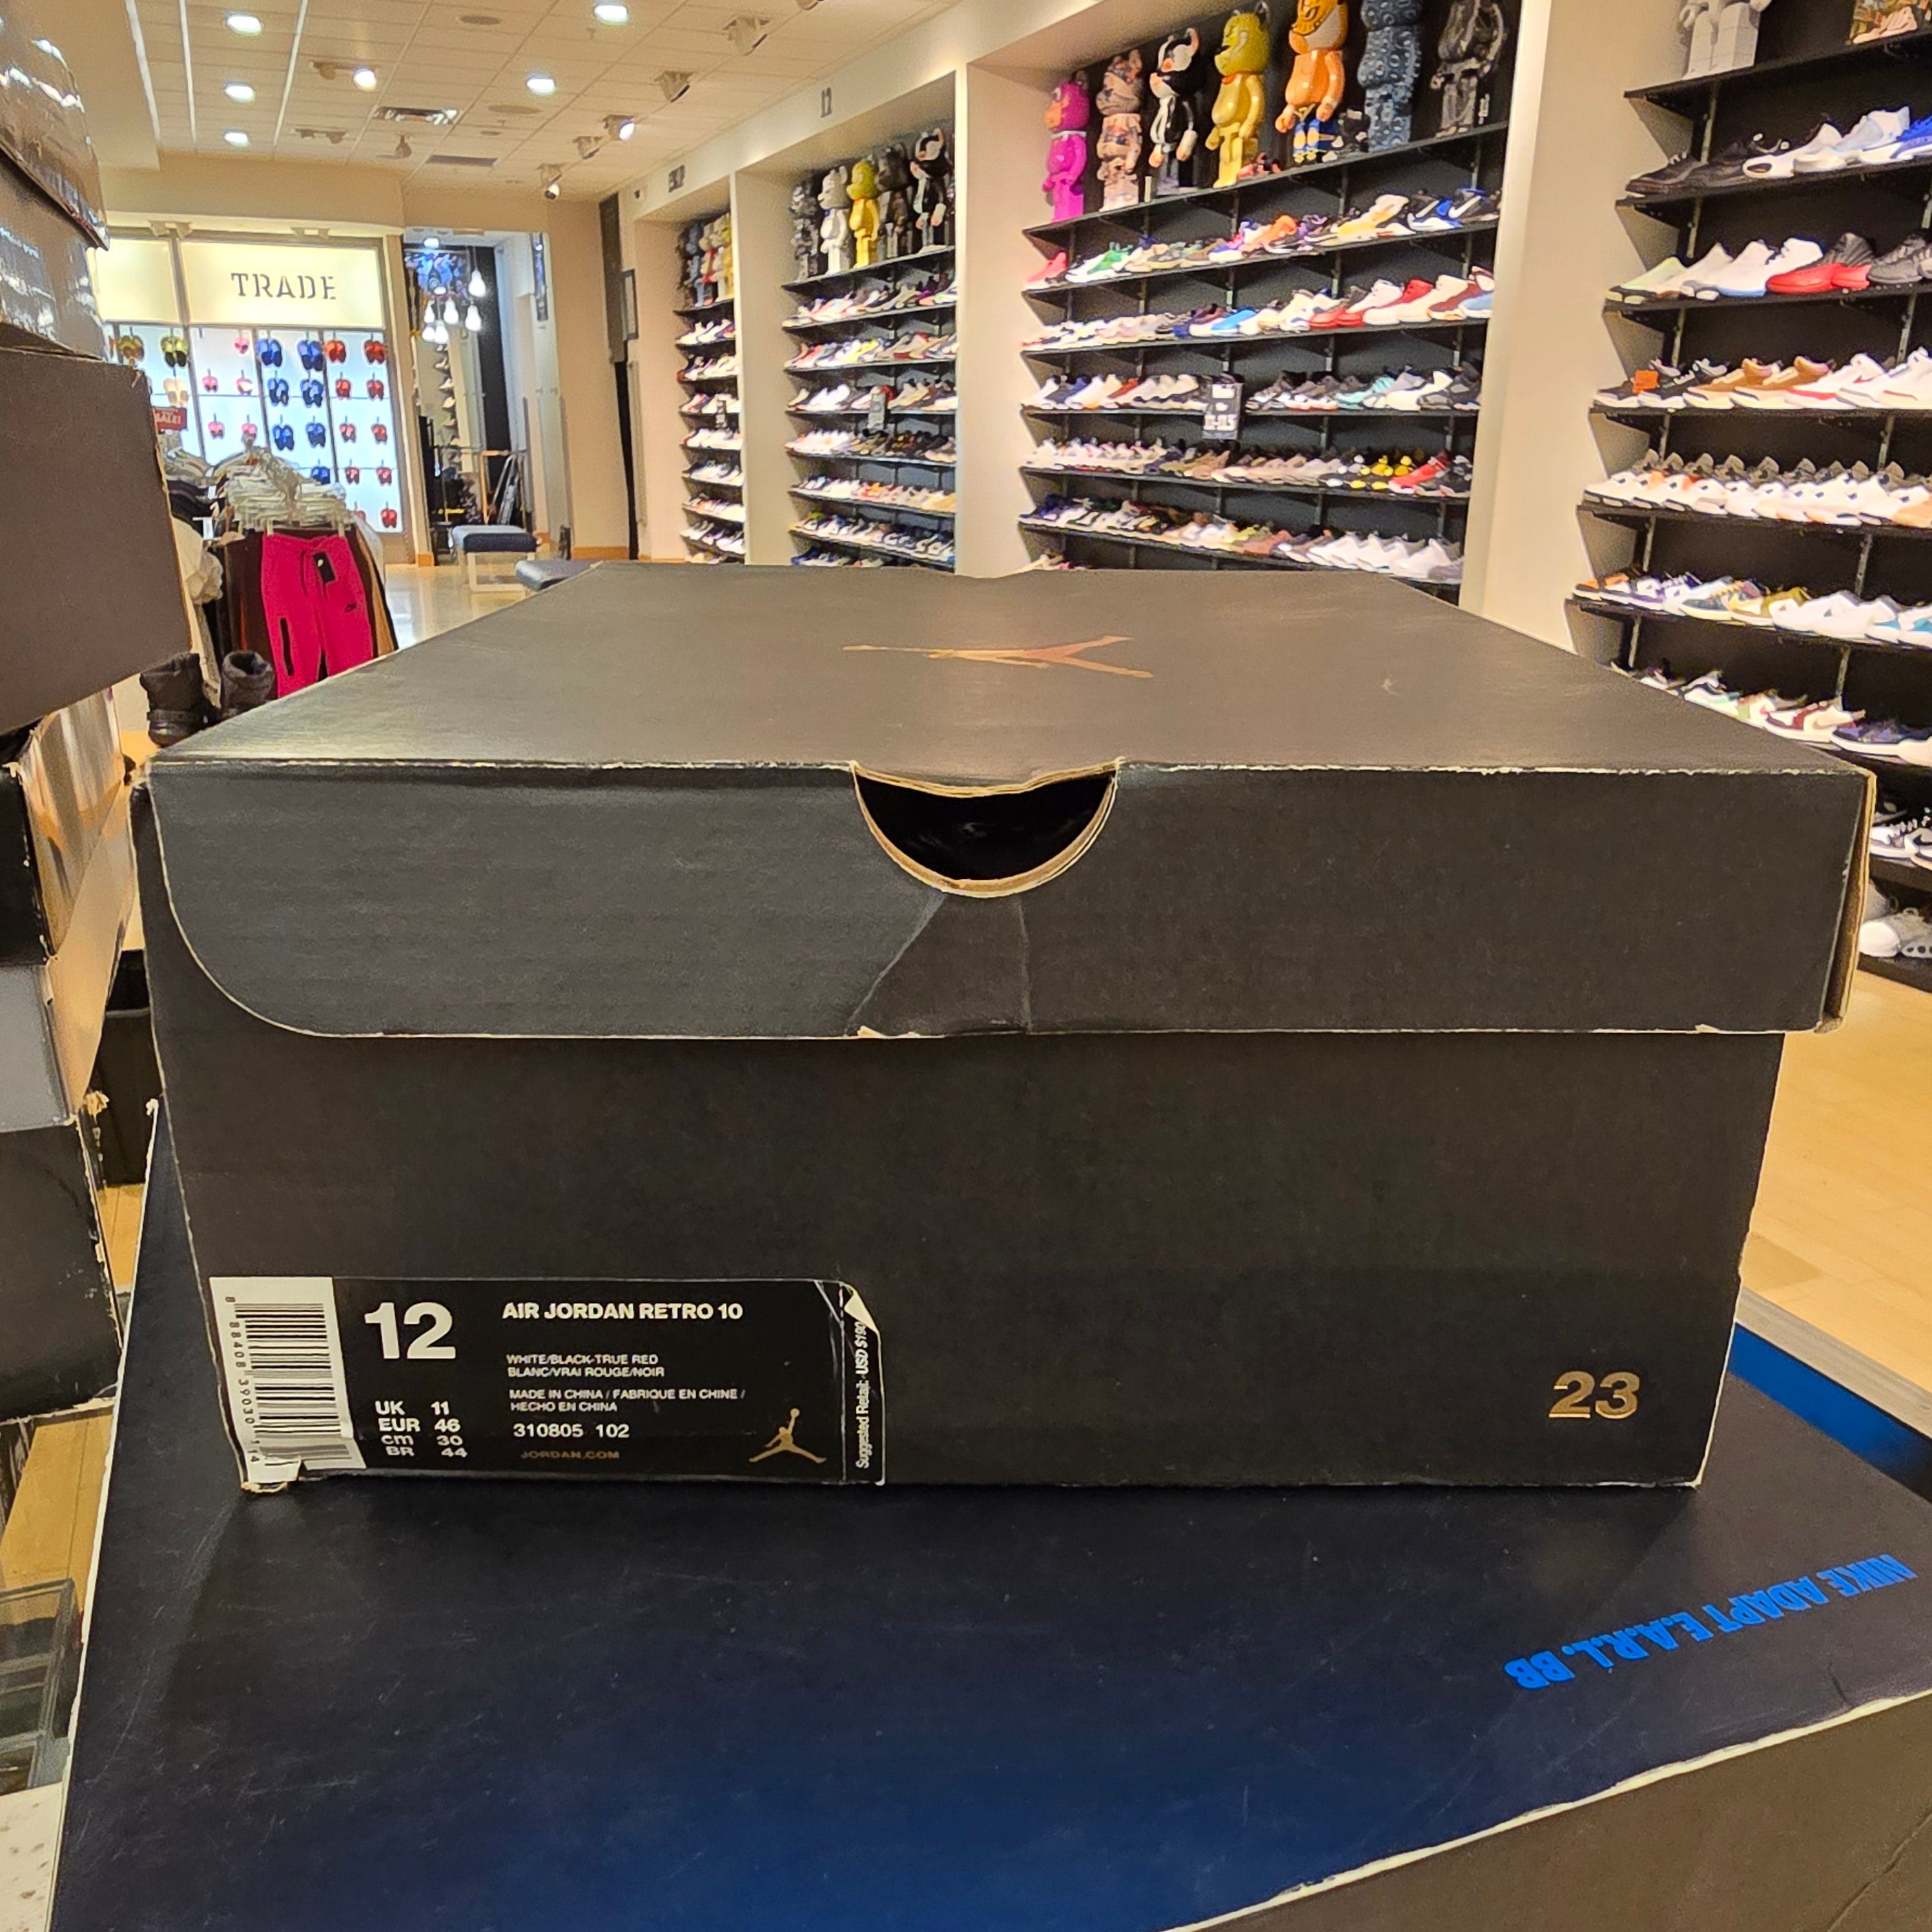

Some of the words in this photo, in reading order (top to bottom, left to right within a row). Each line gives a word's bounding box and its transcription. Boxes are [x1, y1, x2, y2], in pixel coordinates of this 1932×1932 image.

[231, 272, 336, 300] TRADE
[502, 1302, 539, 1319] AIR
[544, 1302, 635, 1319] JORDAN
[639, 1303, 714, 1319] RETRO
[718, 1303, 743, 1319] 10
[364, 1302, 456, 1359] 12
[632, 1354, 659, 1364] RED
[855, 1349, 868, 1375] USD
[508, 1367, 582, 1377] BLANC/VRAI
[584, 1366, 665, 1377] ROUGE/NOIR
[238, 1379, 255, 1424] 39030
[509, 1390, 546, 1399] MADE
[549, 1390, 562, 1399] IN
[564, 1390, 603, 1399] CHINA
[613, 1389, 675, 1399] FABRIQUE
[679, 1389, 696, 1399] EN
[699, 1389, 737, 1399] CHINE
[1550, 1372, 1640, 1419] 23
[375, 1401, 405, 1415] UK
[431, 1401, 449, 1415] 11
[511, 1402, 555, 1412] HECHO
[559, 1402, 576, 1412] EN
[579, 1402, 617, 1412] CHINA
[378, 1418, 420, 1432] EUR
[434, 1419, 460, 1433] 46
[513, 1423, 584, 1437] 310805
[595, 1424, 630, 1438] 102
[437, 1435, 463, 1446] 30
[855, 1415, 872, 1468] Suggested
[385, 1446, 415, 1457] BR
[440, 1448, 468, 1457] 44
[521, 1451, 620, 1459] JORDAN.COM
[1816, 1554, 1918, 1597] NIKE
[1702, 1576, 1829, 1632] ADAPT
[1561, 1612, 1714, 1668] E.A.R.L.
[1504, 1651, 1576, 1689] BB
